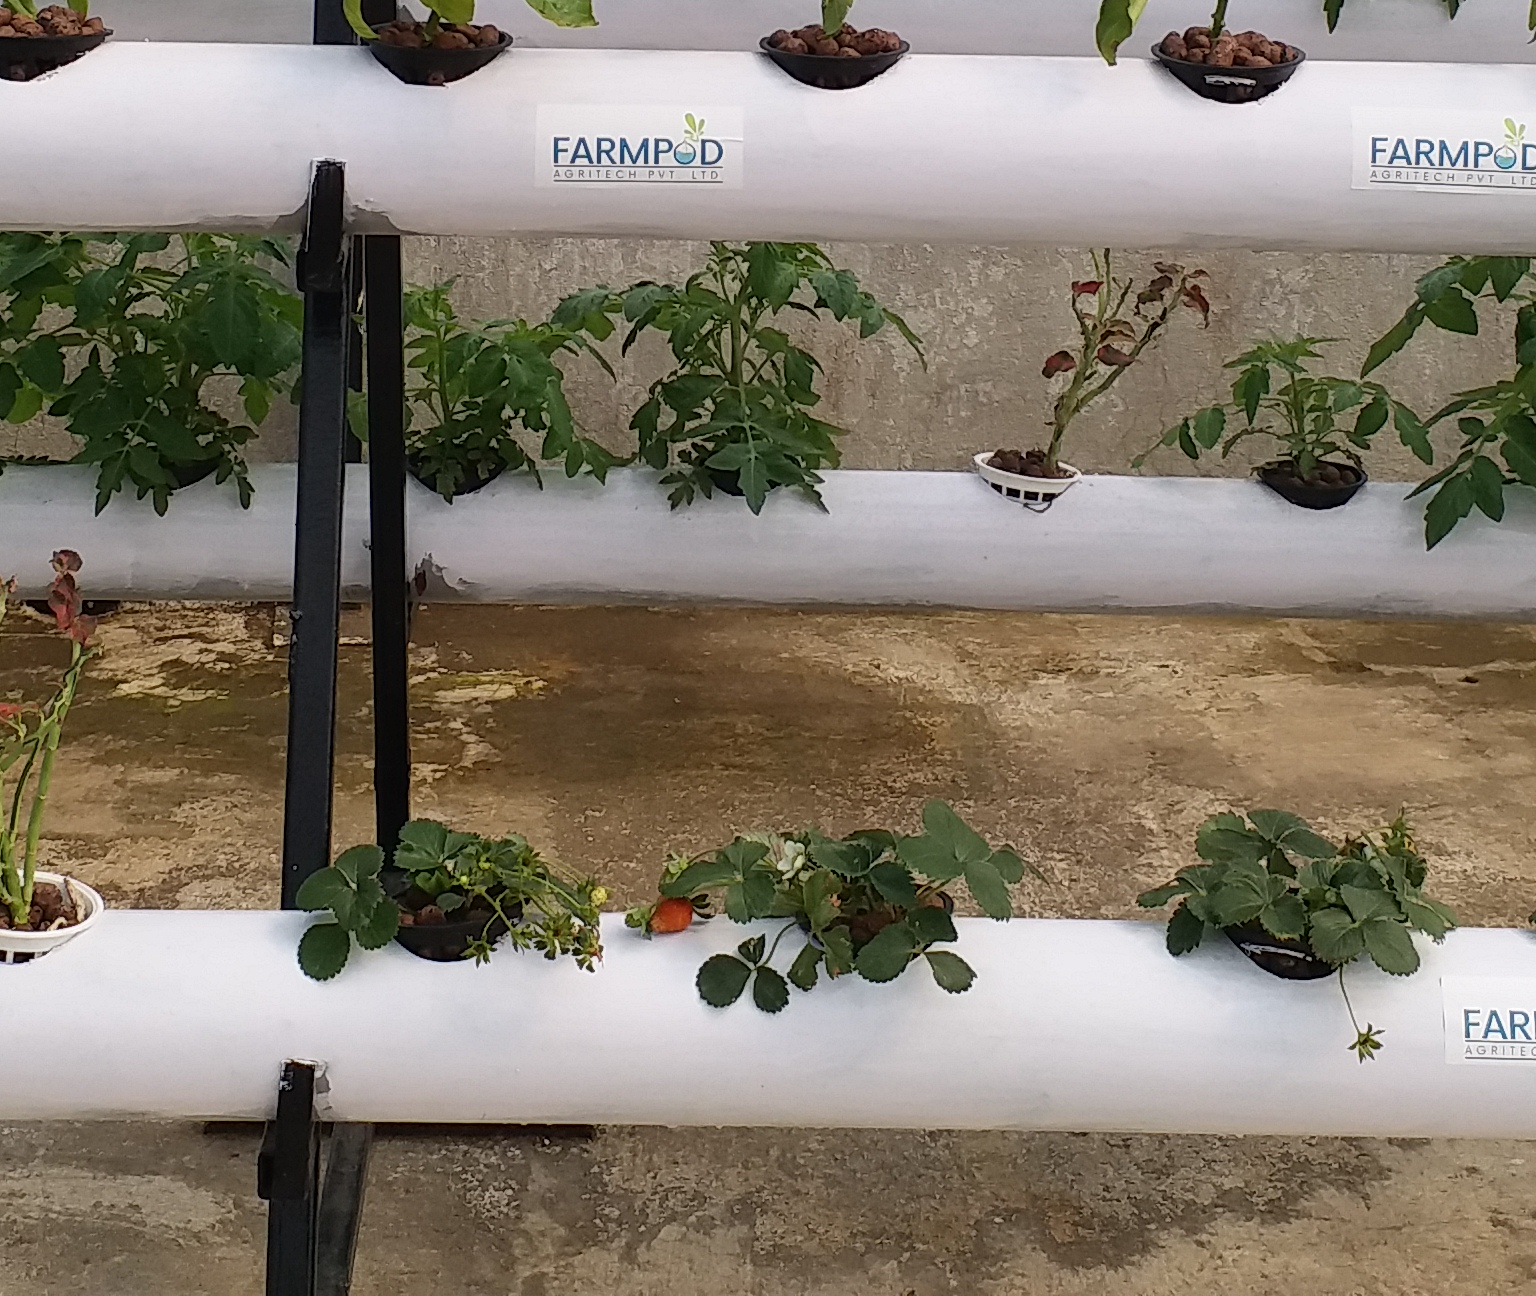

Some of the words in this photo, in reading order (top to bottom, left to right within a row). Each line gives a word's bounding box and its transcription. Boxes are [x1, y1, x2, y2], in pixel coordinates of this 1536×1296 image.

[554, 137, 723, 165] FARMPOD
[554, 170, 636, 179] AGRITECH
[1370, 170, 1455, 182] AGRITECH
